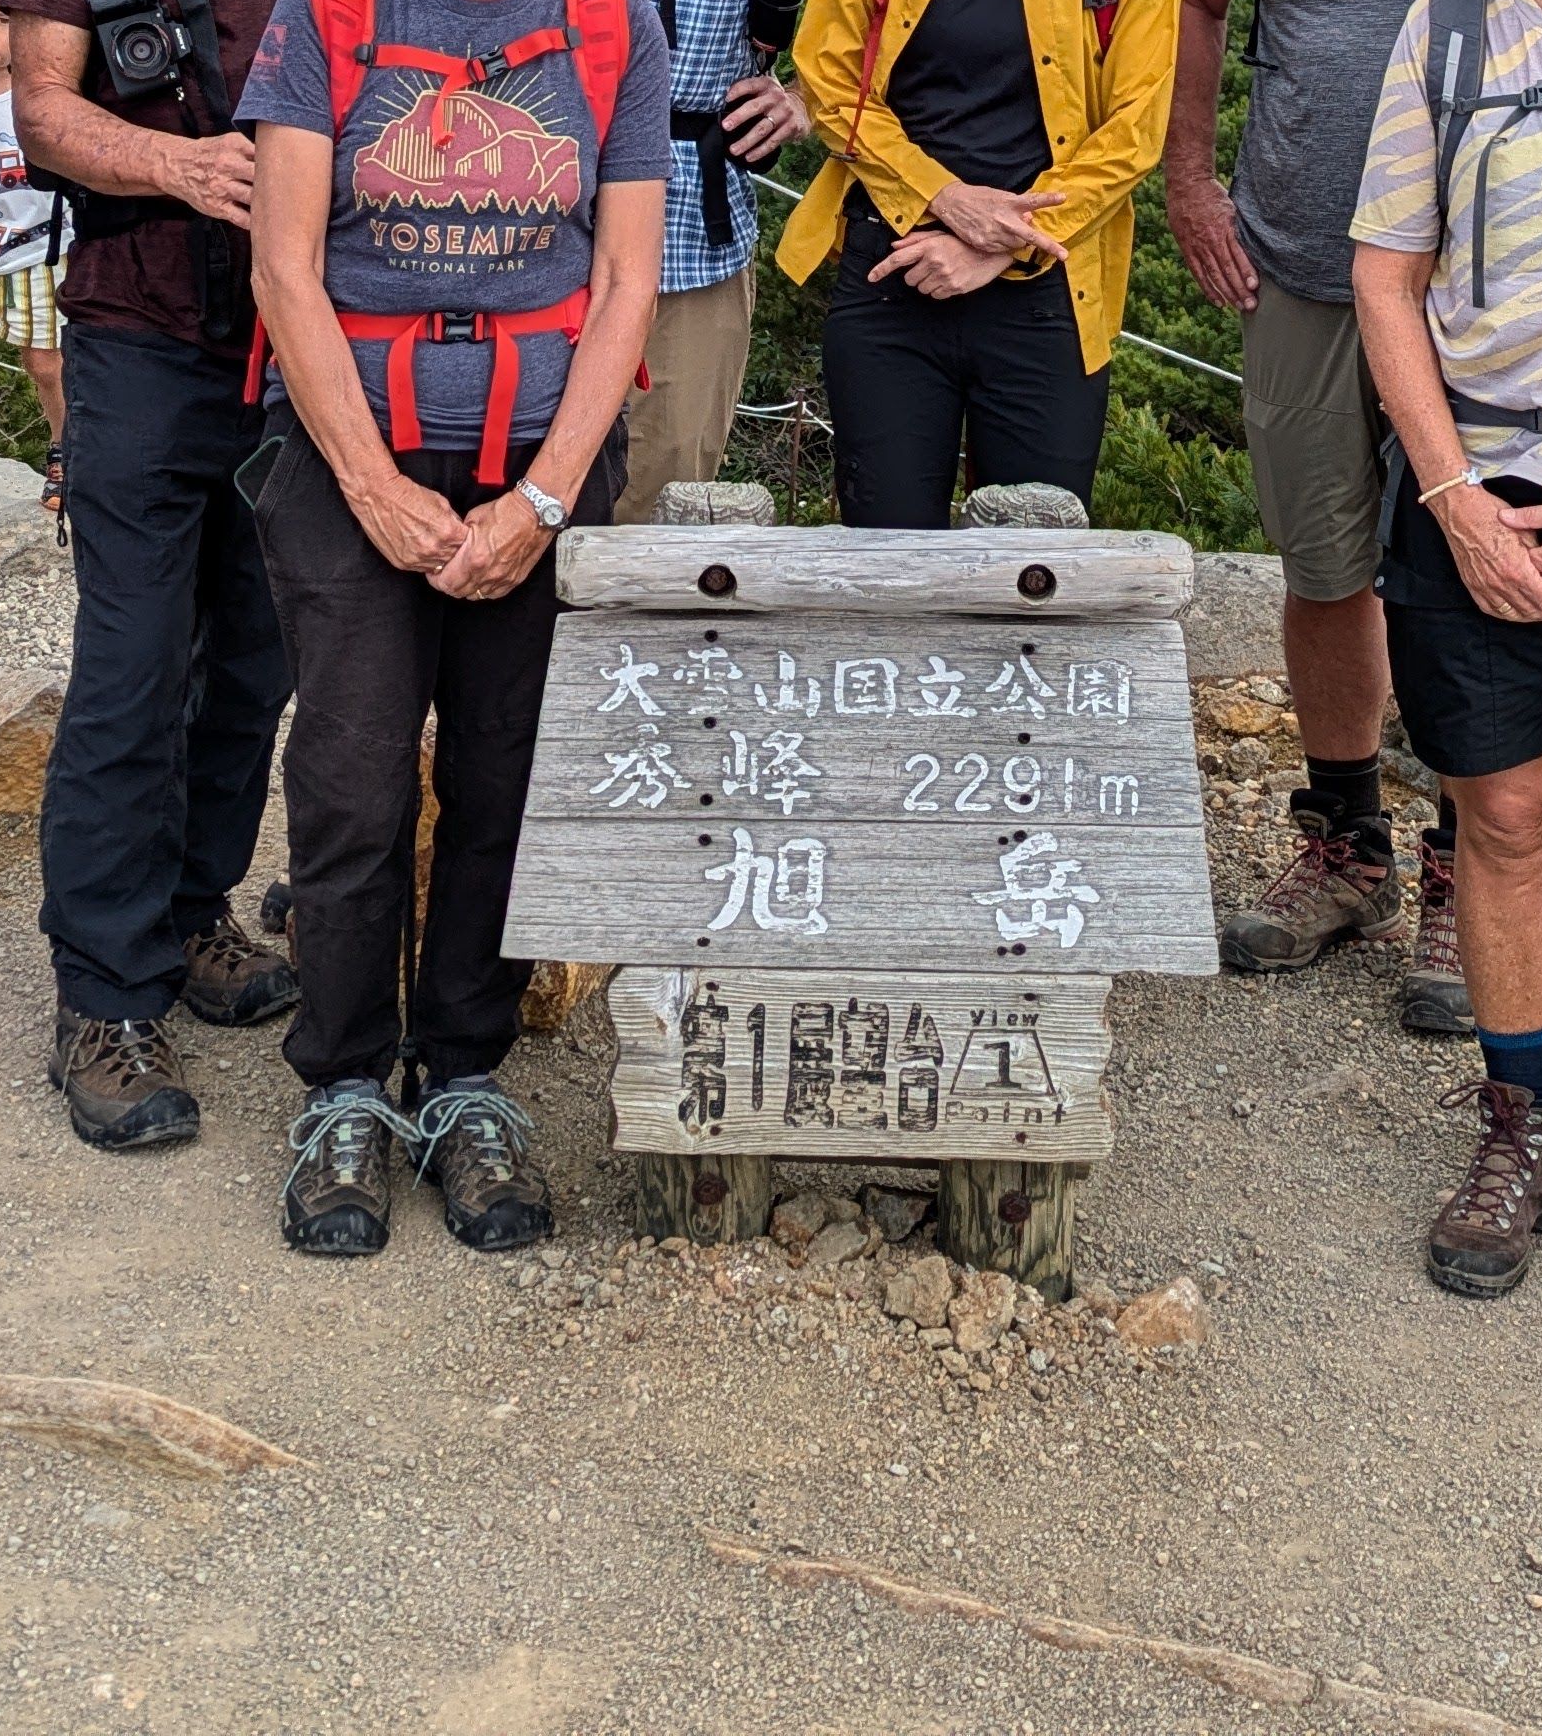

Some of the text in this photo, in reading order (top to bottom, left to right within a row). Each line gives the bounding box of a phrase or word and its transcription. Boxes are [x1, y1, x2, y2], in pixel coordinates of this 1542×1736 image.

[369, 217, 556, 256] YOSEMITE
[388, 257, 525, 274] NATIONAL PARK
[596, 643, 1131, 721] 大雪山国立公園
[983, 1041, 1022, 1089] 1
[945, 1101, 1067, 1124] Point
